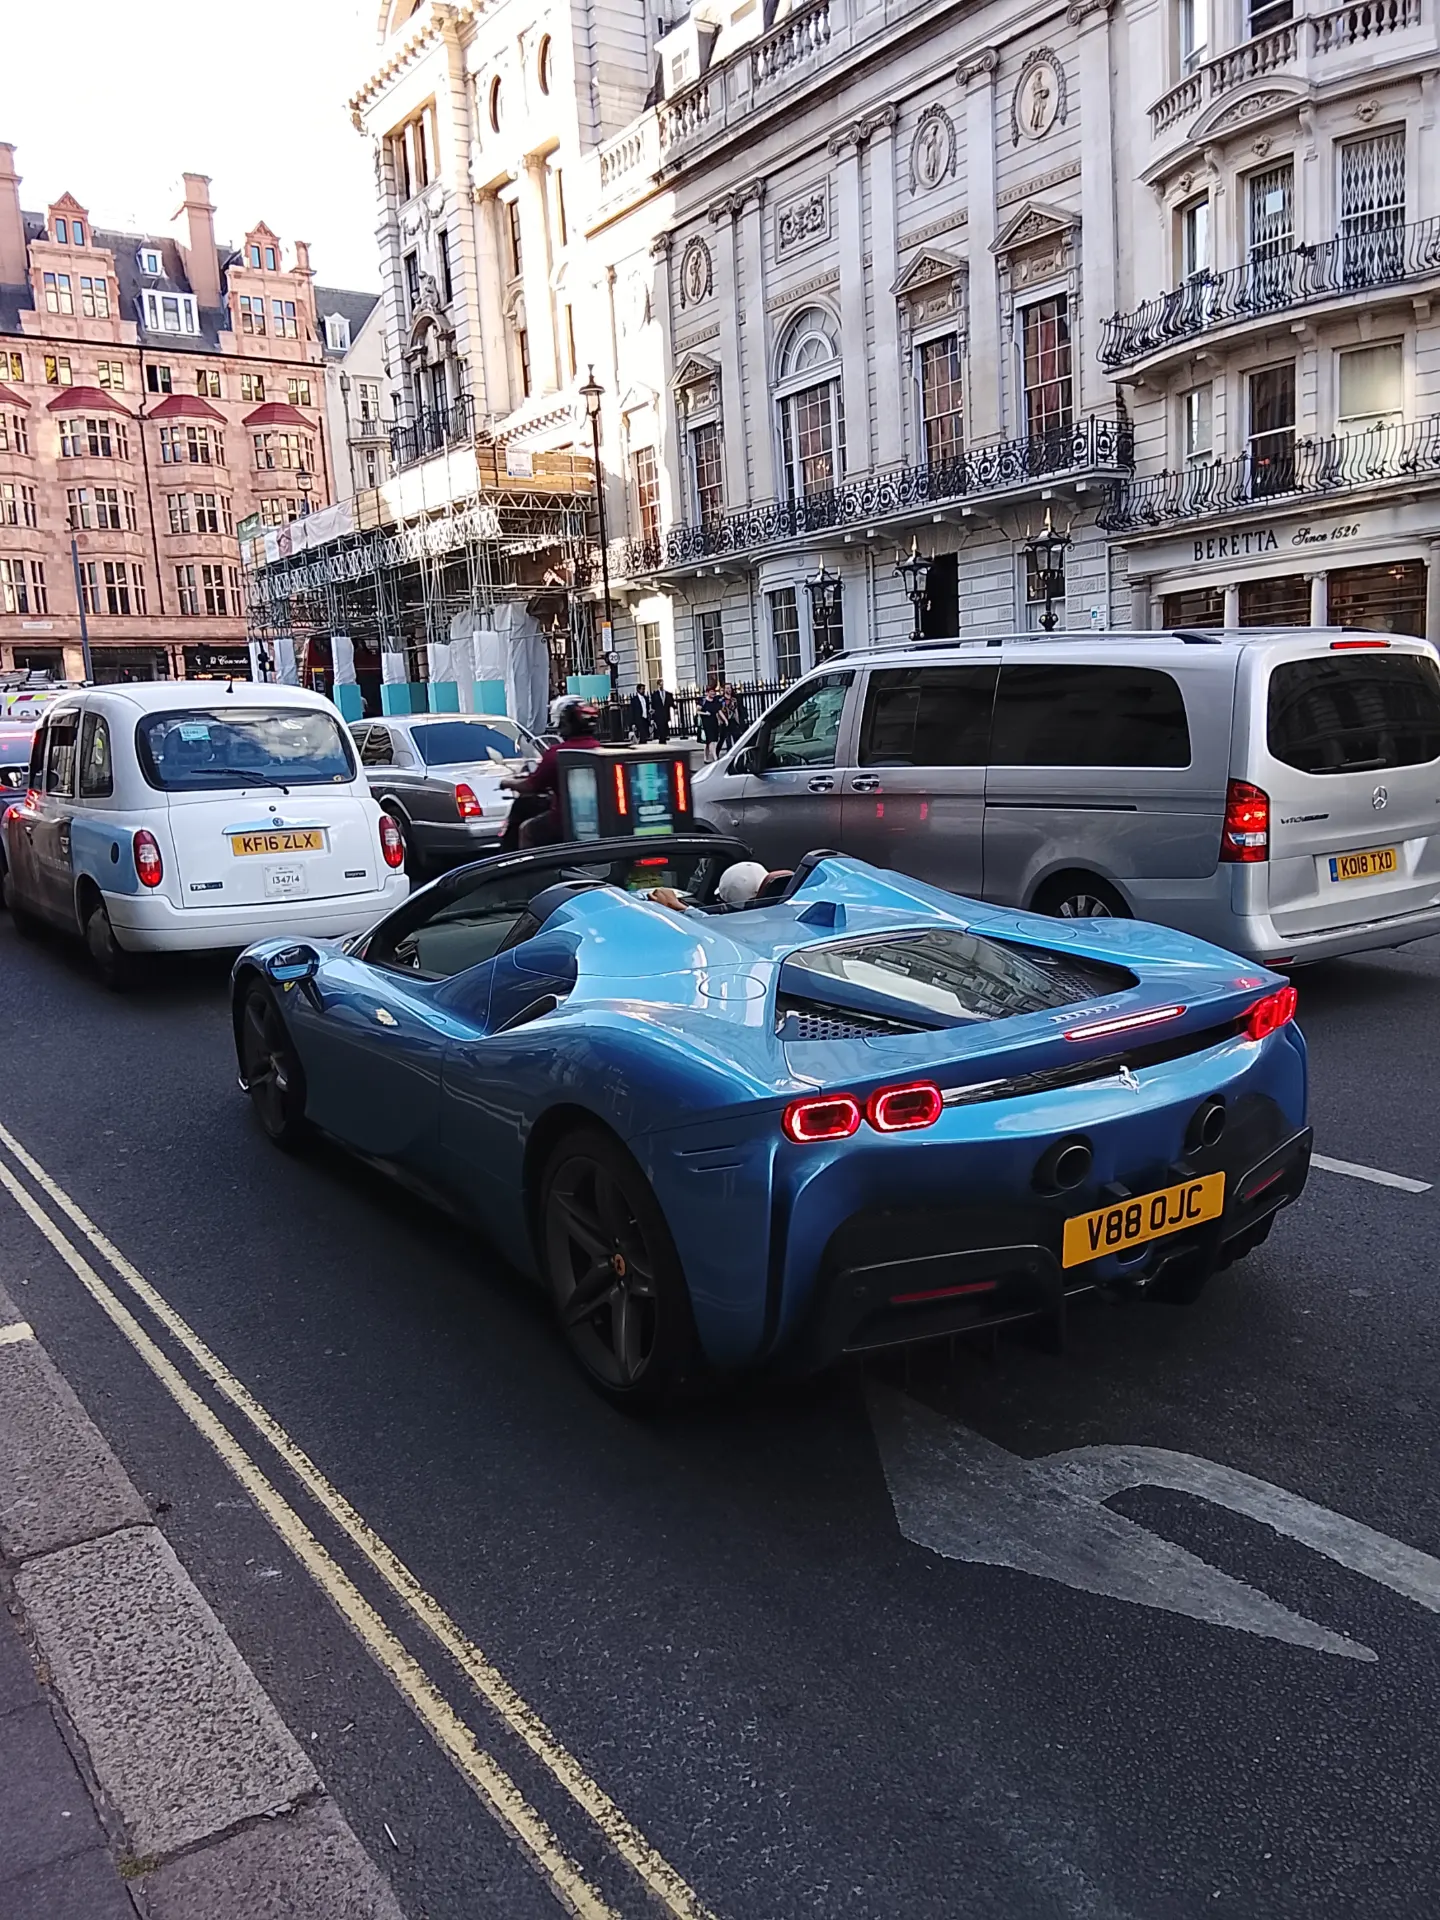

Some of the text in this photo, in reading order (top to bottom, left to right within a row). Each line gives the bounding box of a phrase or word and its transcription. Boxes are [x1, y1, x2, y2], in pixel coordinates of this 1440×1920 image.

[1193, 529, 1279, 561] BERETTA
[1291, 523, 1361, 546] Since 1526
[242, 833, 314, 853] KF16 ZLX
[1341, 851, 1393, 877] KO18 TXD
[272, 875, 300, 885] 134714
[1087, 1184, 1203, 1251] V88 OJC
